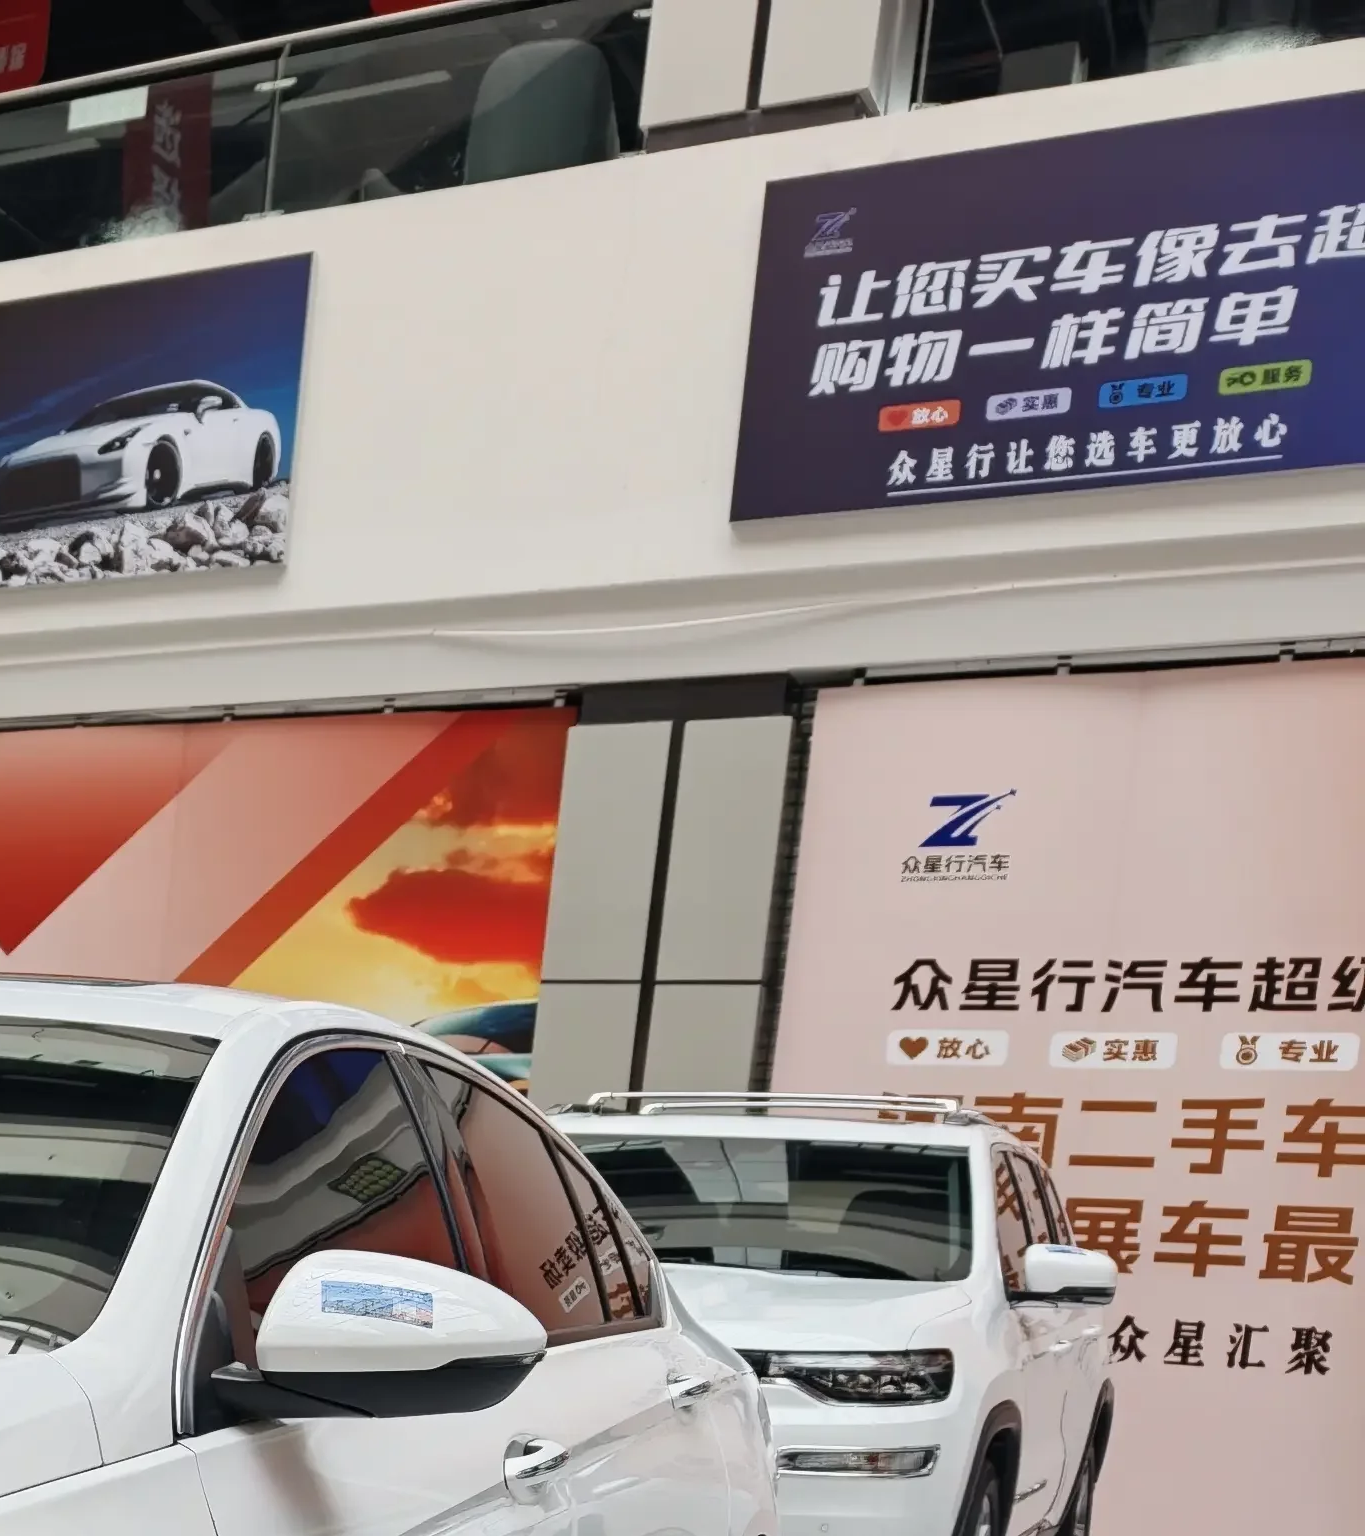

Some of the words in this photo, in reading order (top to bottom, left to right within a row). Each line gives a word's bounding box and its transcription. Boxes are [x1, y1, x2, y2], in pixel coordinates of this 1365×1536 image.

[816, 202, 1365, 328] 让您买车像去超
[808, 285, 1299, 397] 购物一样简单
[1262, 366, 1306, 386] 服务
[1137, 379, 1177, 399] 专业
[1021, 393, 1060, 412] 实惠
[911, 406, 950, 426] 放心
[885, 413, 1289, 488] 众星行让您选车更放心
[900, 853, 1011, 875] 众星行汽车
[891, 955, 1365, 1013] 众星行汽车超级
[936, 1036, 991, 1061] 放心
[1102, 1036, 1160, 1062] 实惠
[1278, 1038, 1340, 1063] 专业
[1107, 1314, 1334, 1376] 众星汇聚
